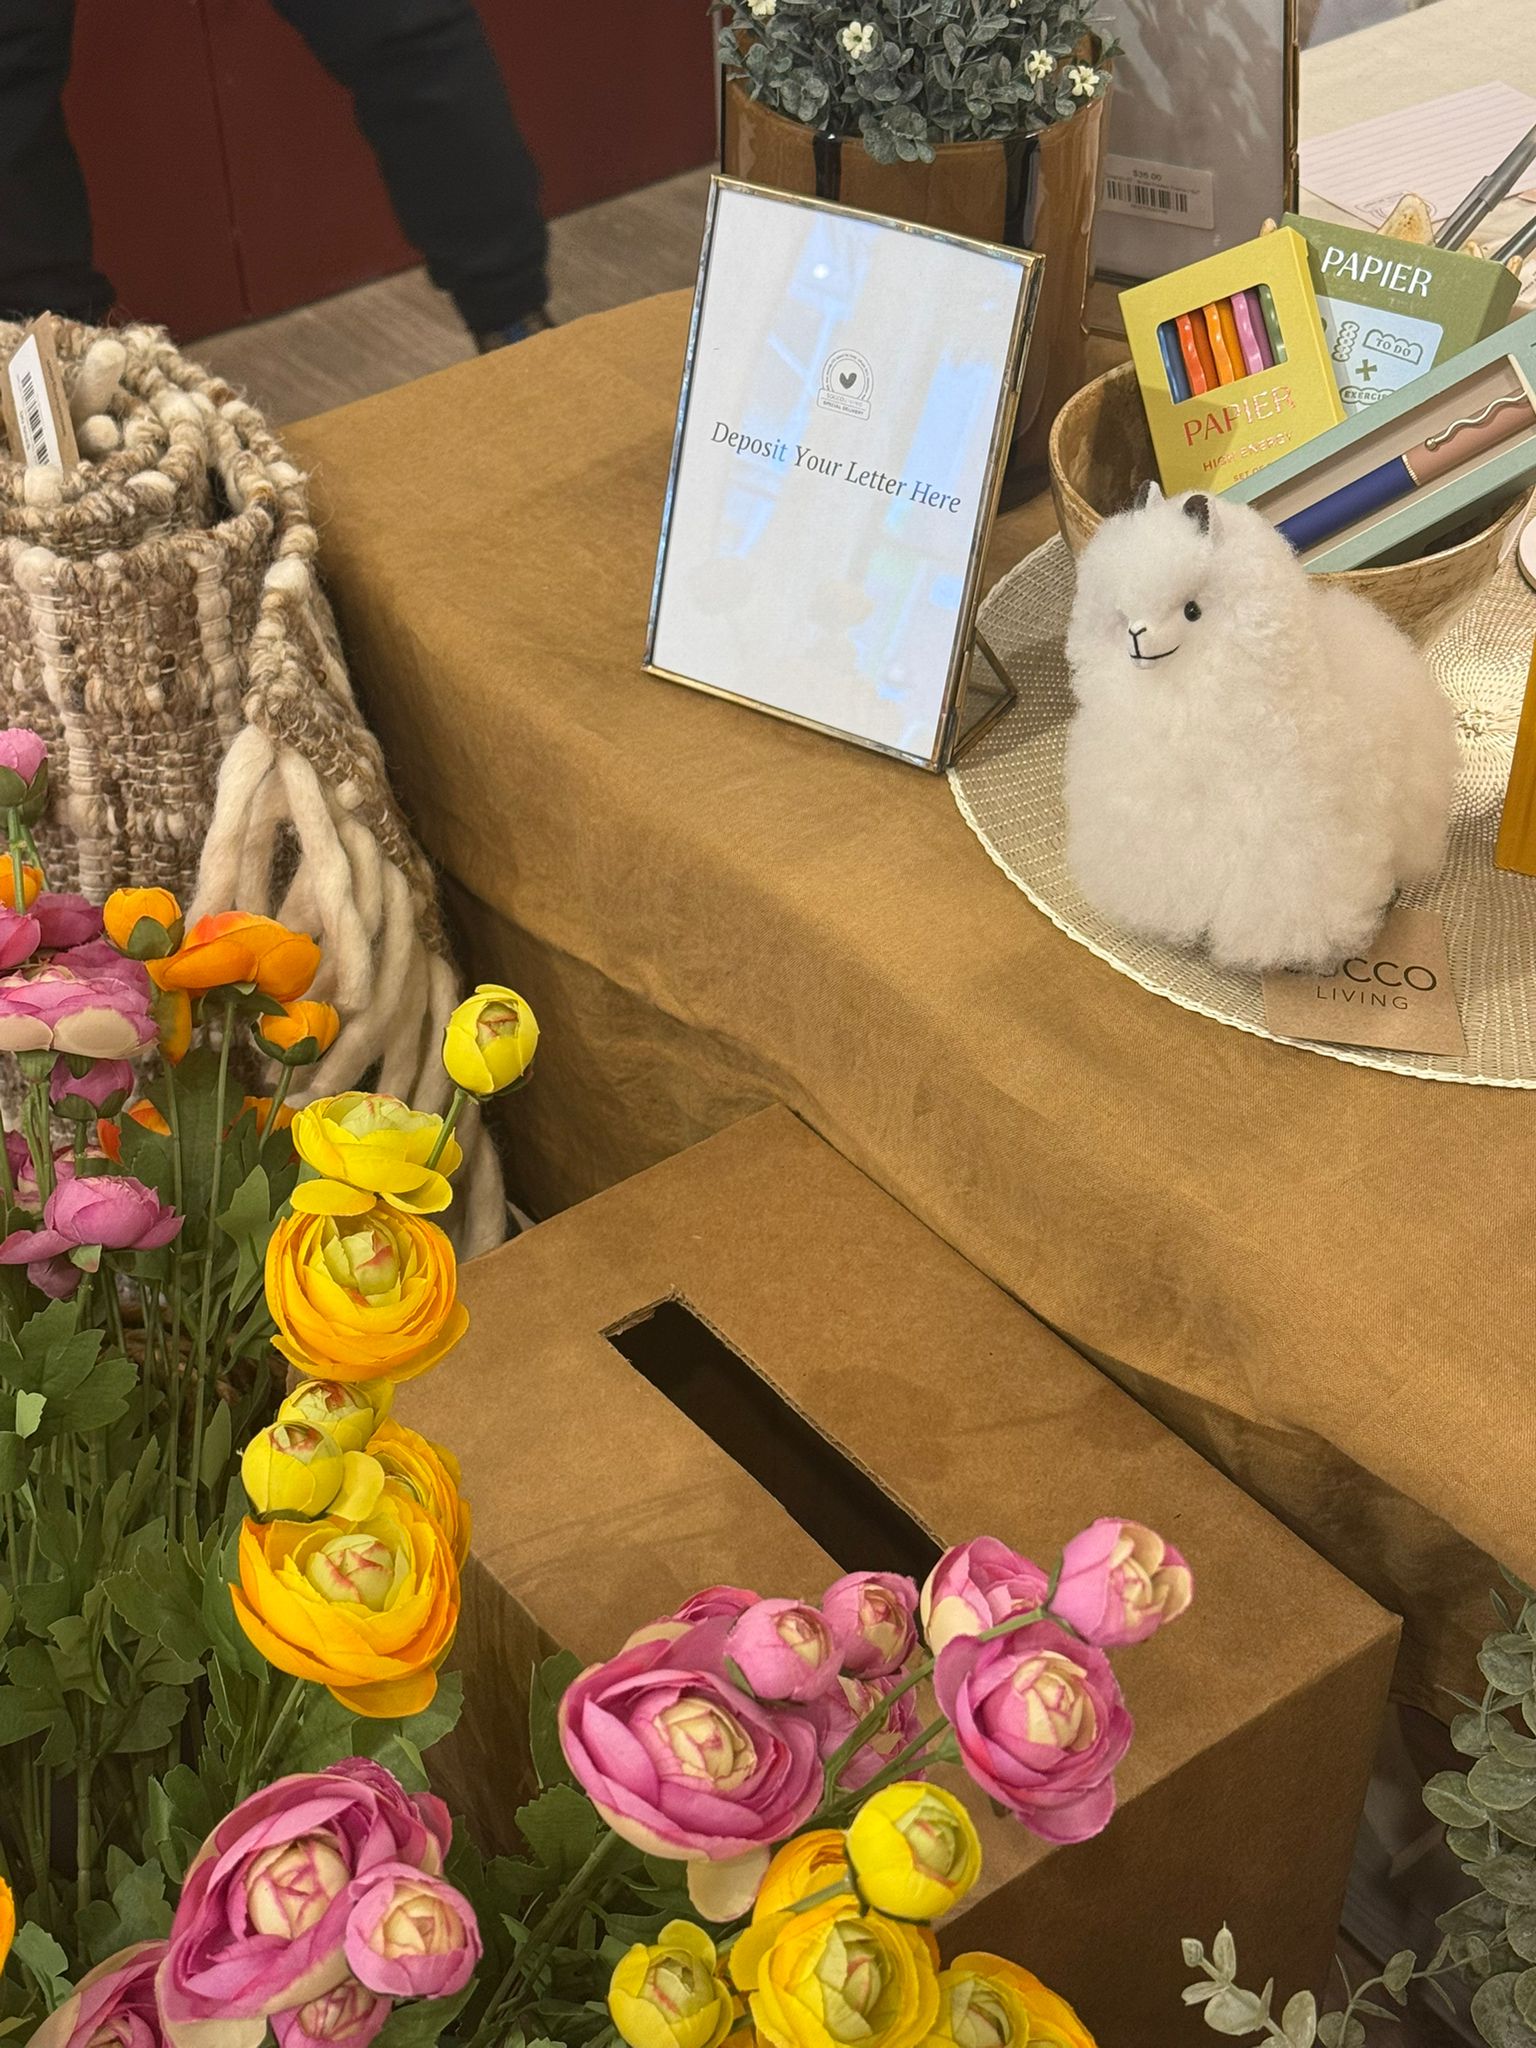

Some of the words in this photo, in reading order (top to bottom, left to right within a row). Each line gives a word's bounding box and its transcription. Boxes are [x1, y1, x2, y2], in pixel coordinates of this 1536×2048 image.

[1320, 246, 1433, 297] PAPIER
[1375, 338, 1391, 350] TO
[1393, 346, 1412, 357] DO
[1344, 390, 1388, 401] EXERCI
[1183, 385, 1296, 447] PAPIER
[710, 421, 788, 462] Deposit
[794, 445, 842, 476] Your
[844, 461, 907, 496] Letter
[909, 480, 961, 513] Here
[1202, 452, 1236, 472] HIGH
[1240, 431, 1293, 457] ENERGY
[1233, 469, 1250, 482] SET
[1341, 957, 1437, 992] CCO
[1317, 985, 1408, 1010] LIVING
